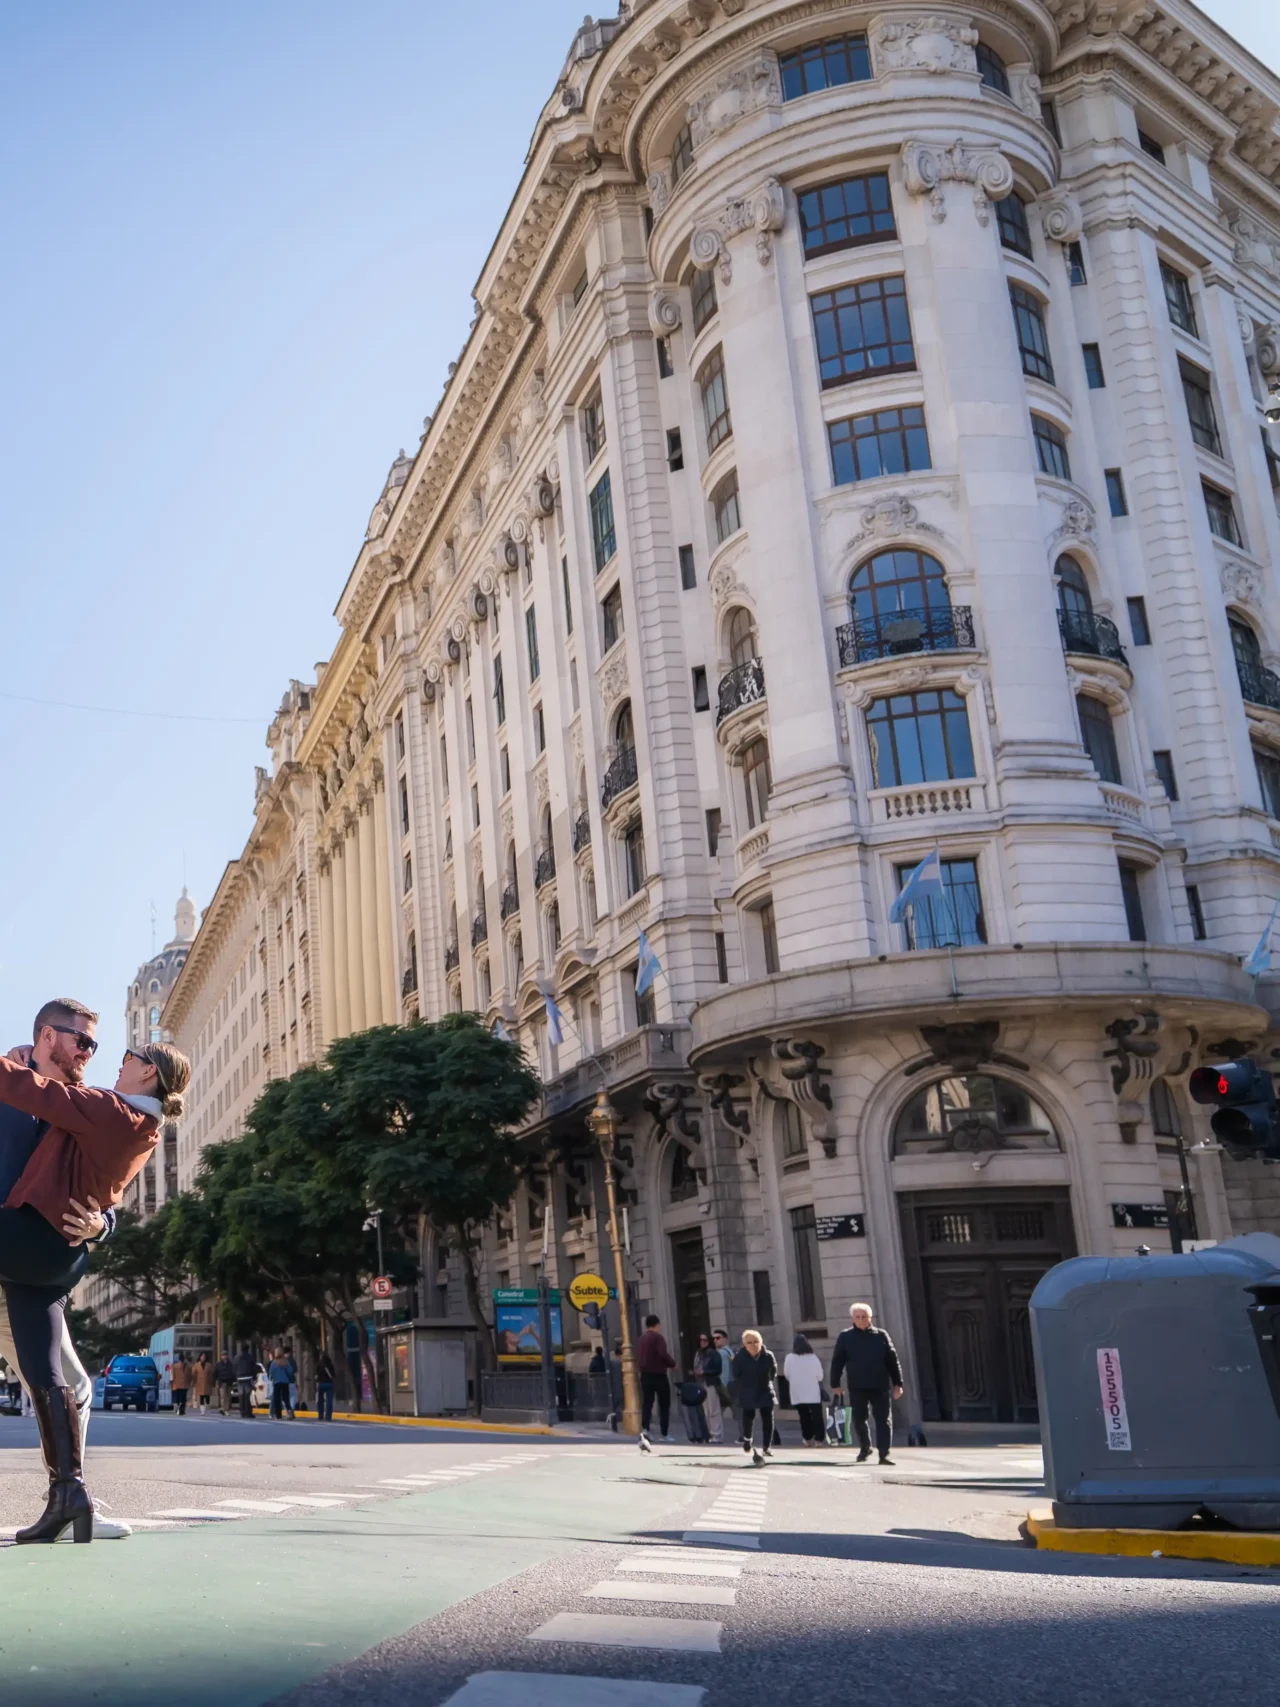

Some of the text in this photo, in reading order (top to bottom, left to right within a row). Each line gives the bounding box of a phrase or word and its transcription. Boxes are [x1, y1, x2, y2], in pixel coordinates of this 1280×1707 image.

[497, 1290, 524, 1298] Catedral
[574, 1285, 604, 1295] Subte
[1103, 1351, 1122, 1431] 155505
